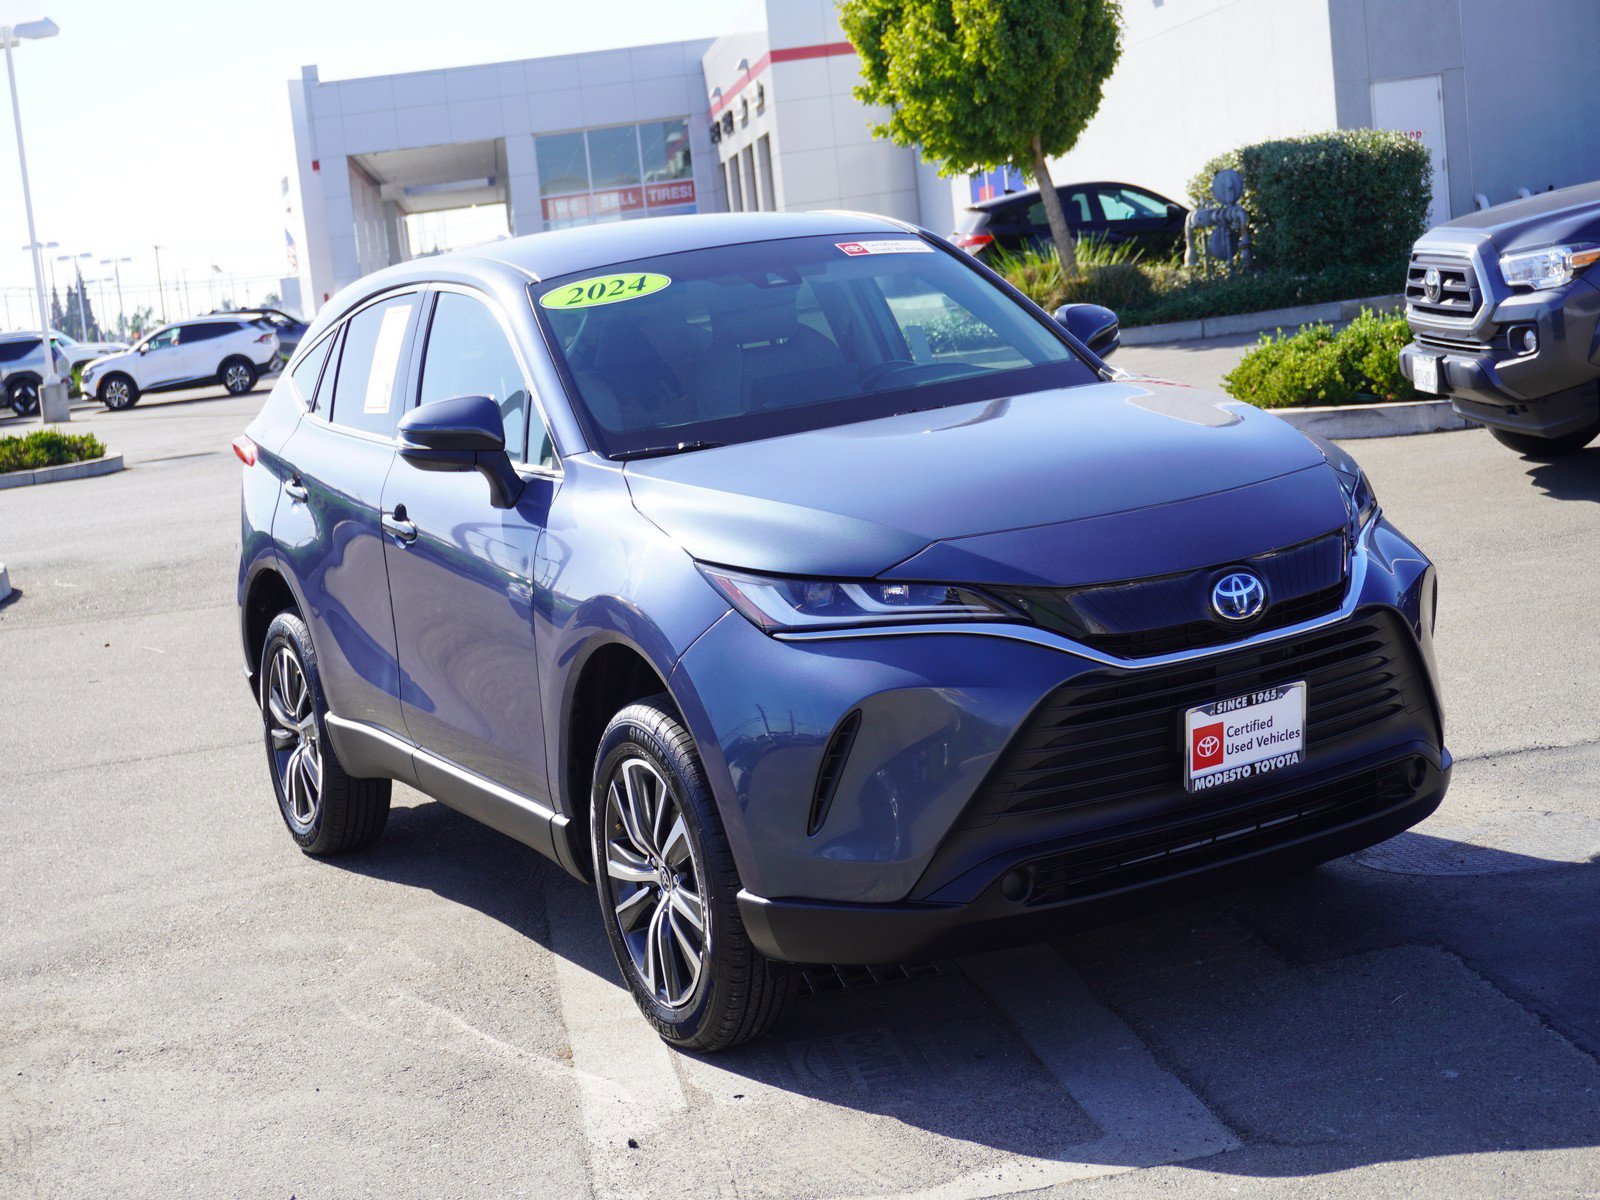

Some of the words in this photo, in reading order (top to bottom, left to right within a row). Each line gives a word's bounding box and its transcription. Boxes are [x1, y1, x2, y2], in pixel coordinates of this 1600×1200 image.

[601, 192, 636, 209] SELL
[648, 185, 693, 202] TIRES!
[566, 275, 647, 306] 2024
[1216, 696, 1248, 714] SINCE
[1251, 689, 1277, 705] 1965
[1226, 716, 1273, 738] Certified
[1226, 737, 1253, 755] Used
[1256, 728, 1301, 748] Vehicles
[1194, 764, 1252, 792] MODESTO
[1254, 753, 1299, 775] TOYOTA
